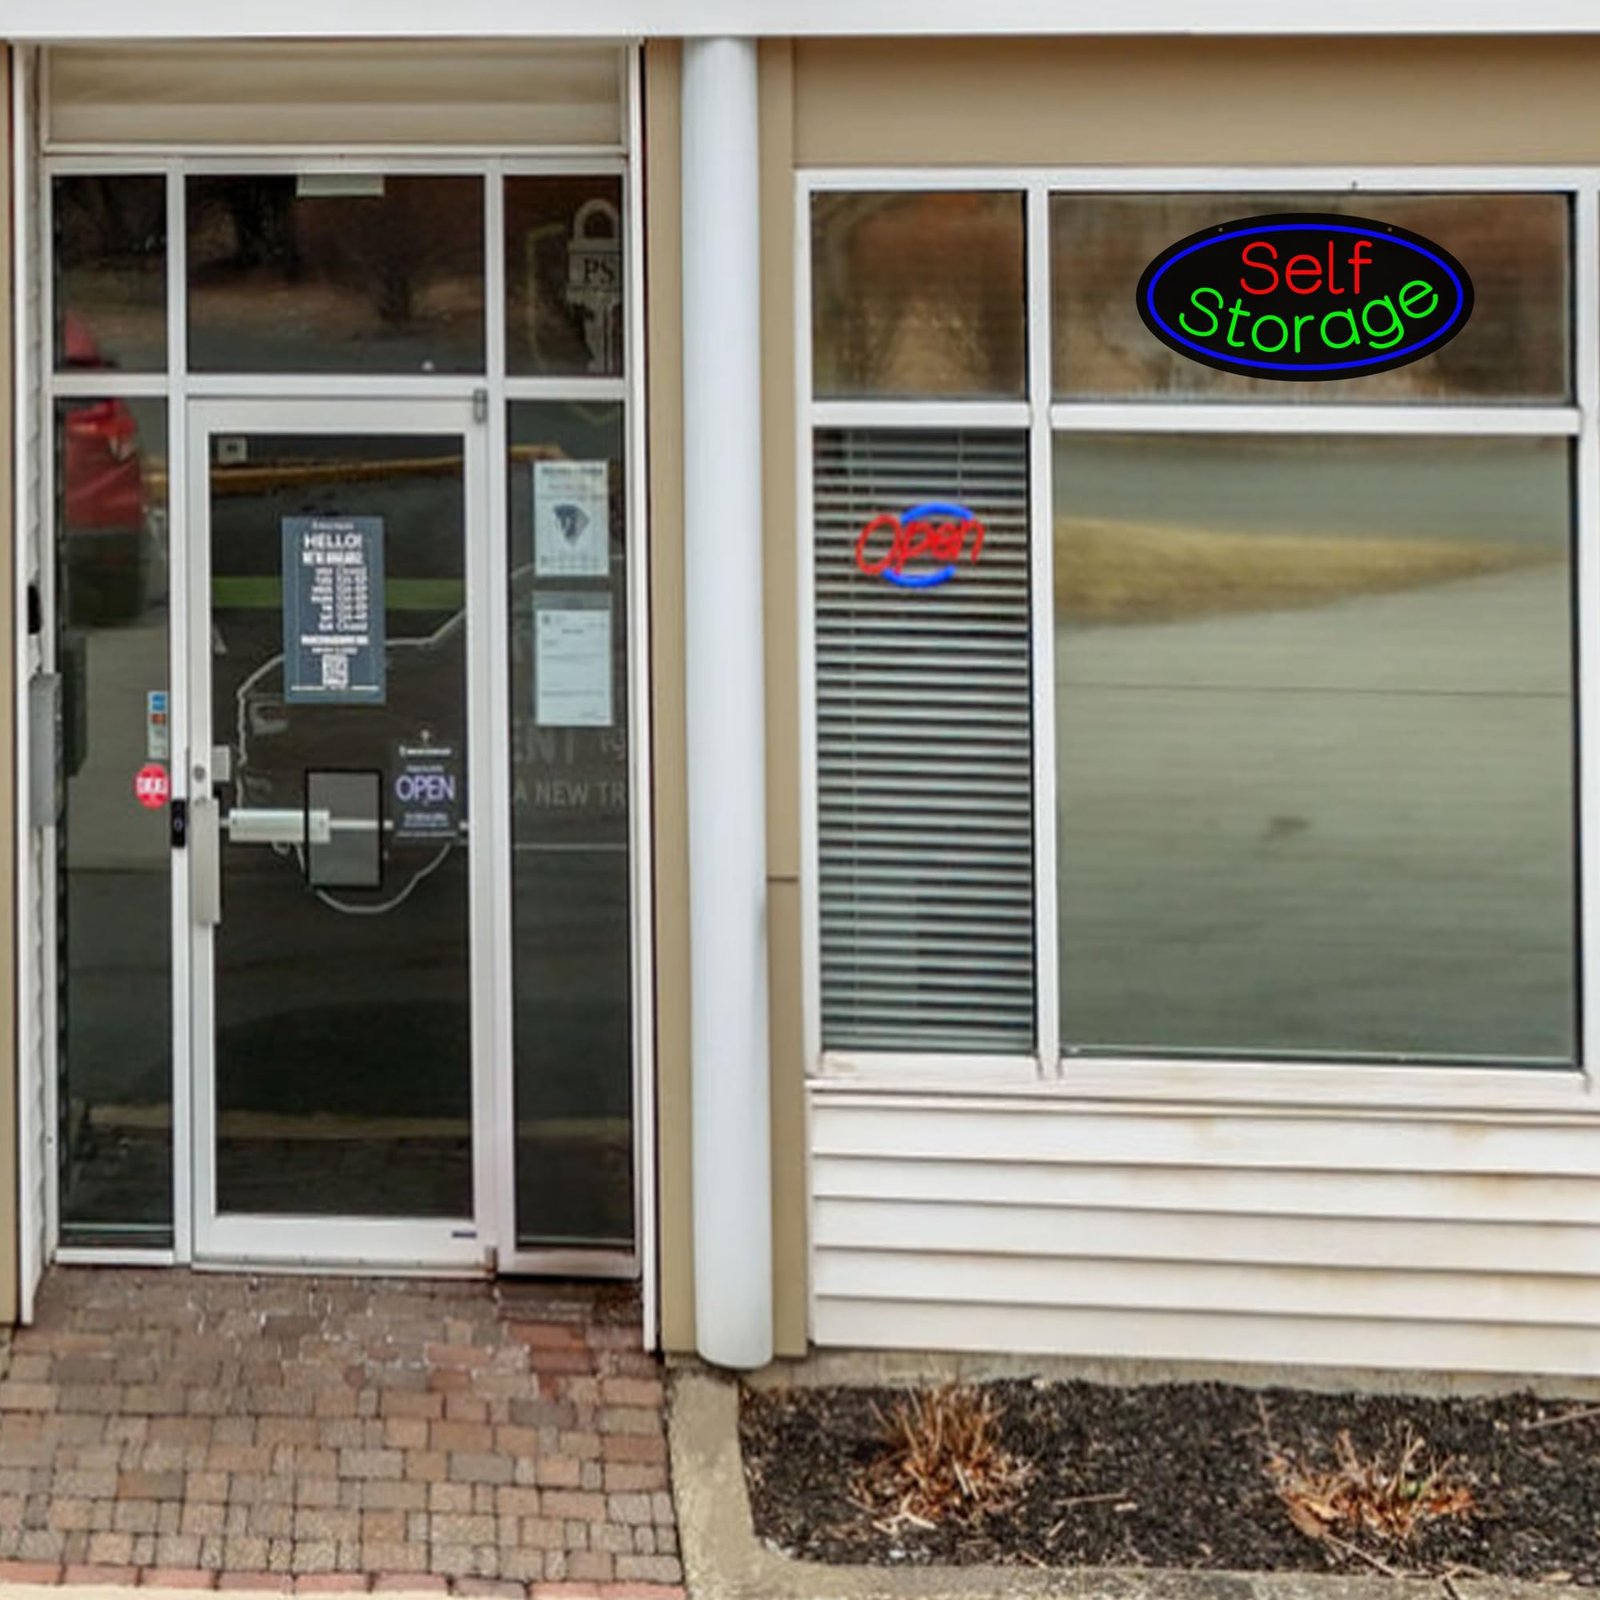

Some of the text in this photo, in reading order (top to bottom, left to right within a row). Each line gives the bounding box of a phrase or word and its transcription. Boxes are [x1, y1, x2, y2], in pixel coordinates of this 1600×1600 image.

[584, 257, 615, 284] PS
[1240, 240, 1373, 295] Self
[1178, 279, 1439, 353] Storage
[855, 514, 986, 576] Open
[396, 775, 456, 802] OPEN
[535, 780, 588, 807] NEW
